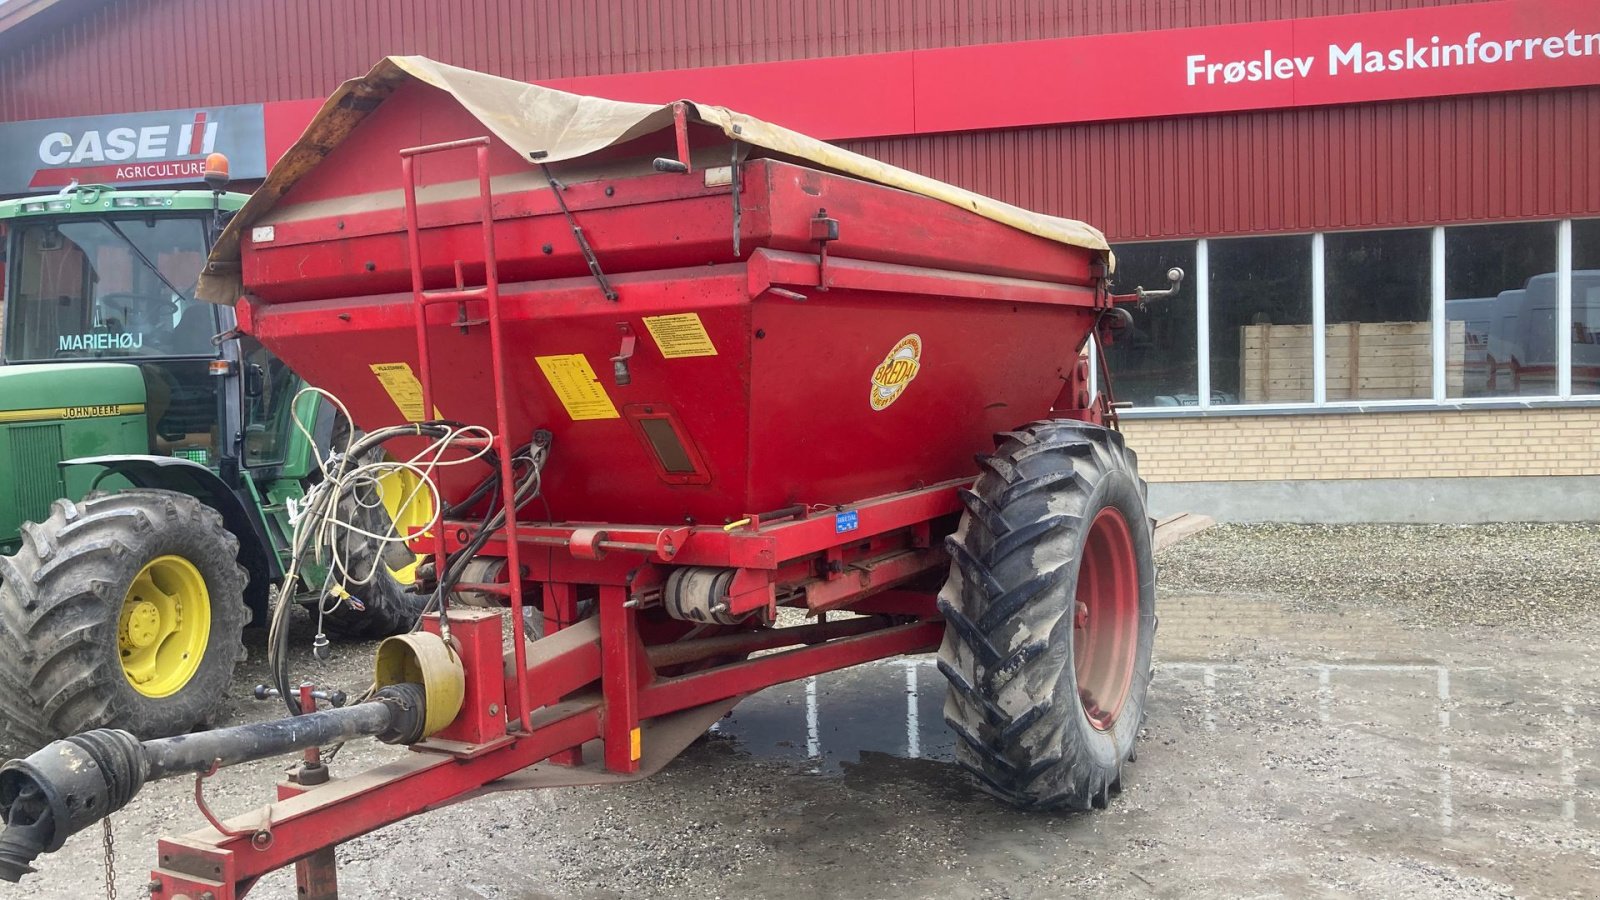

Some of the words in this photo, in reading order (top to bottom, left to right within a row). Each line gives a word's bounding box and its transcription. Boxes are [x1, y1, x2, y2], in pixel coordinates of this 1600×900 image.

[1186, 49, 1315, 86] Frøslev
[39, 125, 170, 165] CASE
[116, 162, 206, 179] AGRICULTURE
[59, 332, 143, 351] MARIEHØJ
[63, 406, 90, 418] JOHN
[92, 404, 121, 416] DEERE
